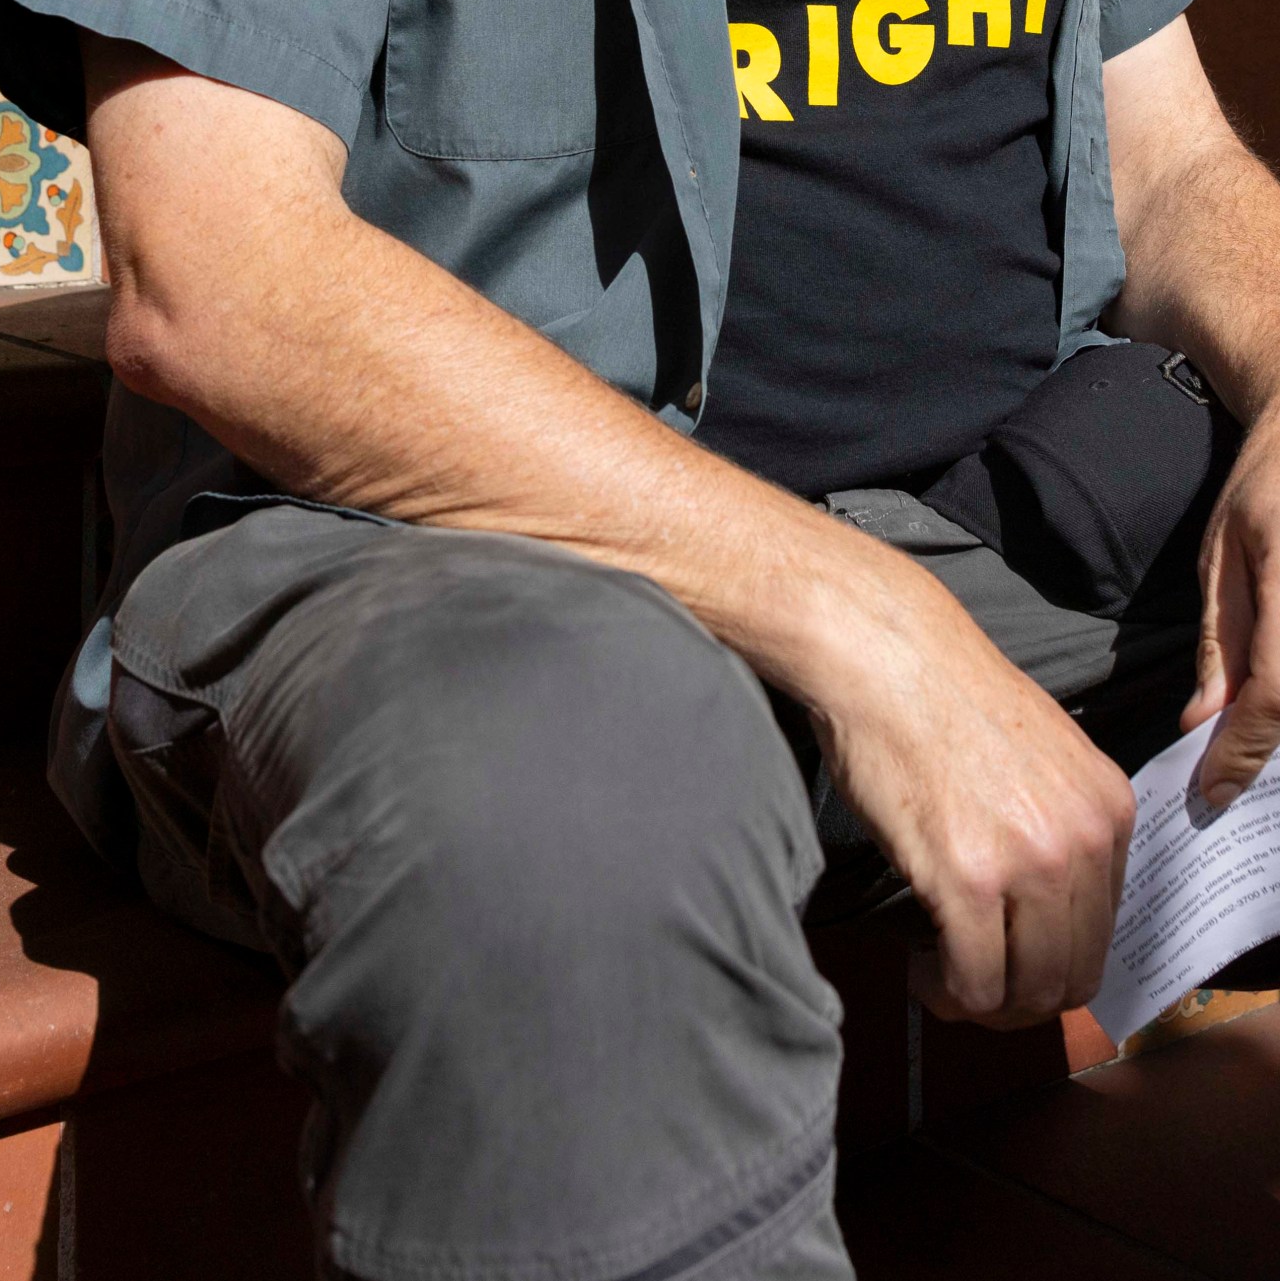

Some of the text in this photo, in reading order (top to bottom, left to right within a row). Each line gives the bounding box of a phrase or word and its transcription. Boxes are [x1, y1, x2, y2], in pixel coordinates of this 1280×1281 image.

[1131, 843, 1170, 883] calculated
[1258, 778, 1268, 788] of
[1151, 807, 1166, 824] you
[1165, 791, 1183, 809] that
[1111, 913, 1152, 951] previously
[1152, 878, 1189, 914] assessed
[1188, 868, 1200, 879] for
[1200, 855, 1217, 869] this
[1234, 833, 1255, 845] You
[1255, 825, 1272, 836] will
[1121, 950, 1137, 964] For
[1138, 932, 1159, 952] more
[1205, 869, 1233, 893] please
[1234, 857, 1252, 871] visit
[1253, 851, 1269, 862] the
[1146, 886, 1168, 909] place
[1167, 875, 1179, 887] for
[1180, 855, 1202, 876] many
[1230, 829, 1237, 837] a
[1238, 813, 1271, 832] clerical
[1137, 962, 1167, 985] Please
[1168, 935, 1196, 963] contact
[1218, 890, 1260, 919] 652-3700
[1261, 886, 1269, 895] if
[1149, 977, 1175, 1000] Thank
